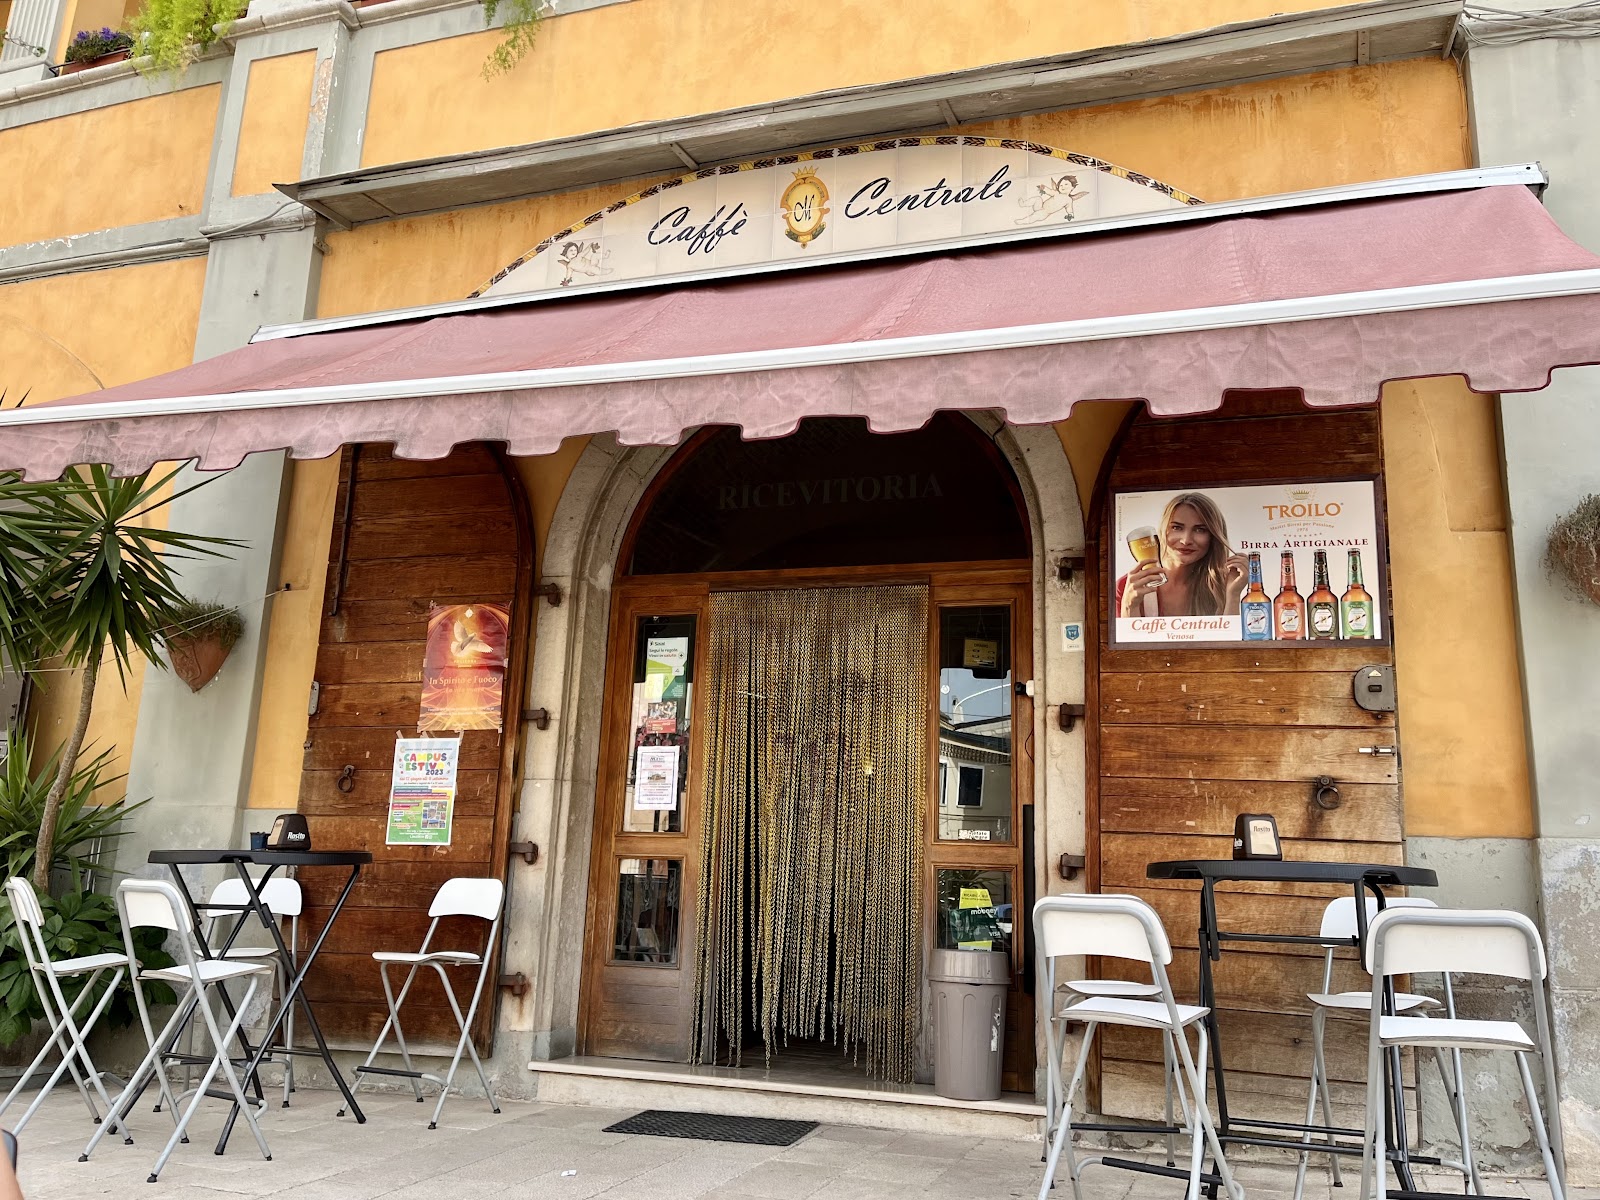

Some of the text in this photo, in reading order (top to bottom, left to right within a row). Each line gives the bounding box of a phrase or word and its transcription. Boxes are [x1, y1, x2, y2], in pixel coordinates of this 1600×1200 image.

[647, 164, 1012, 255] Caffè Centrale
[717, 472, 944, 511] RICEVITORIA
[1263, 502, 1341, 521] TROILO
[1241, 538, 1369, 550] BIRRA ARTIGIANALE
[1131, 618, 1167, 634] Caffè
[1170, 617, 1231, 631] Centrale
[1166, 632, 1195, 640] Venosa
[403, 752, 448, 762] CAMPUS
[405, 761, 445, 771] ESTIVO
[1253, 825, 1271, 833] Rosito
[287, 831, 306, 840] Rosito
